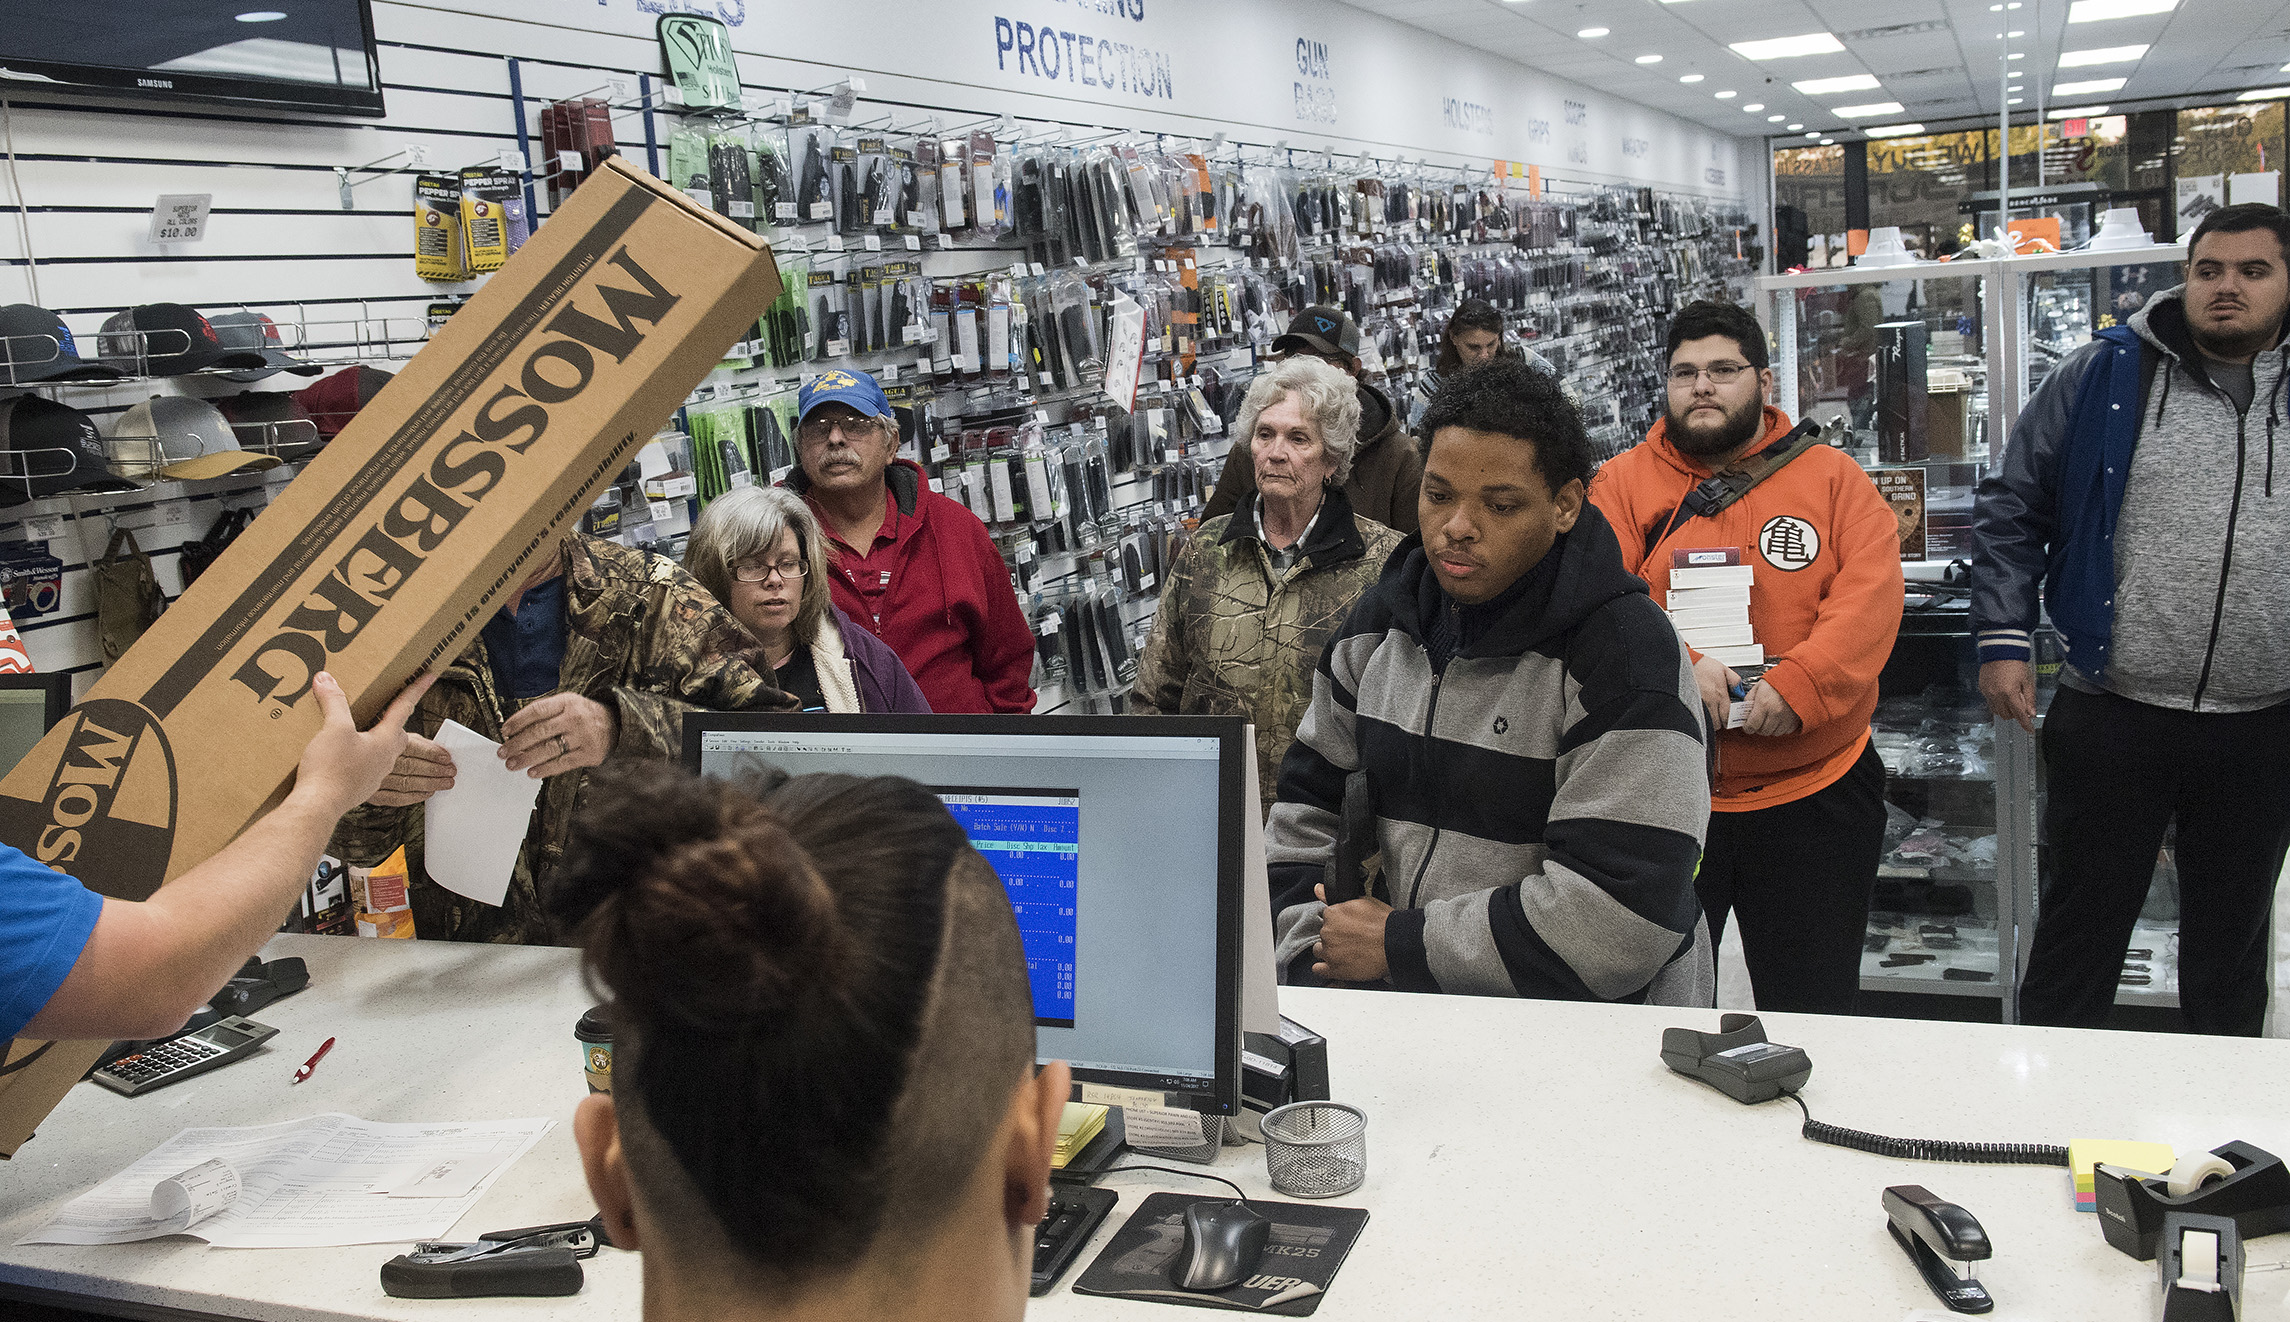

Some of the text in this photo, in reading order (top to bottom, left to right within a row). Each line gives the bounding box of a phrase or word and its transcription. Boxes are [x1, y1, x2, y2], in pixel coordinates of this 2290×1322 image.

[995, 16, 1172, 99] PROTECTION
[1296, 37, 1329, 79] GUN
[137, 78, 173, 89] SAMSUNG
[1443, 96, 1493, 136] HOLSTERS
[463, 177, 516, 187] PEPPER SPRAY
[419, 187, 449, 198] PEPPER
[172, 205, 198, 213] SUPERIOR
[179, 217, 198, 225] COLORS
[160, 227, 198, 238] $10.00
[560, 251, 595, 288] ATTENTION
[884, 264, 905, 274] TAGUA
[808, 274, 830, 284] TAGUA
[474, 350, 488, 363] the
[451, 359, 479, 388] customer
[450, 387, 466, 403] and
[883, 388, 906, 397] AGUA
[419, 407, 434, 422] and
[386, 417, 423, 456] understands
[378, 451, 392, 465] the
[387, 449, 408, 470] which
[230, 244, 682, 708] MOSSBERG
[347, 460, 382, 496] importance
[364, 465, 392, 493] contains
[1881, 476, 1907, 485] UP ON
[342, 492, 353, 503] of
[1891, 492, 1917, 500] GRIND
[329, 498, 347, 516] both
[339, 488, 370, 520] important
[291, 533, 327, 571] operational
[13, 566, 60, 577] Smith&Wesson
[281, 566, 297, 582] and
[245, 577, 286, 619] maintenance
[212, 615, 251, 655] information.
[974, 823, 991, 831] Batch
[994, 824, 1007, 832] Sale
[1010, 824, 1028, 833] (Y/N)
[1043, 825, 1057, 833] Disc
[976, 841, 1074, 852] Price Disc Shp Tax Amount
[1009, 851, 1075, 861] 0.00 0.00
[1008, 878, 1074, 888] 0.00 0.00
[1058, 907, 1074, 916] 0.00
[1058, 935, 1073, 944] 0.00
[1057, 963, 1073, 972] 0.00
[1057, 972, 1073, 981] 0.00
[1057, 981, 1072, 990] 0.00
[1056, 990, 1072, 999] 0.00
[1262, 1245, 1321, 1258] MK25
[1243, 1274, 1302, 1291] UER
